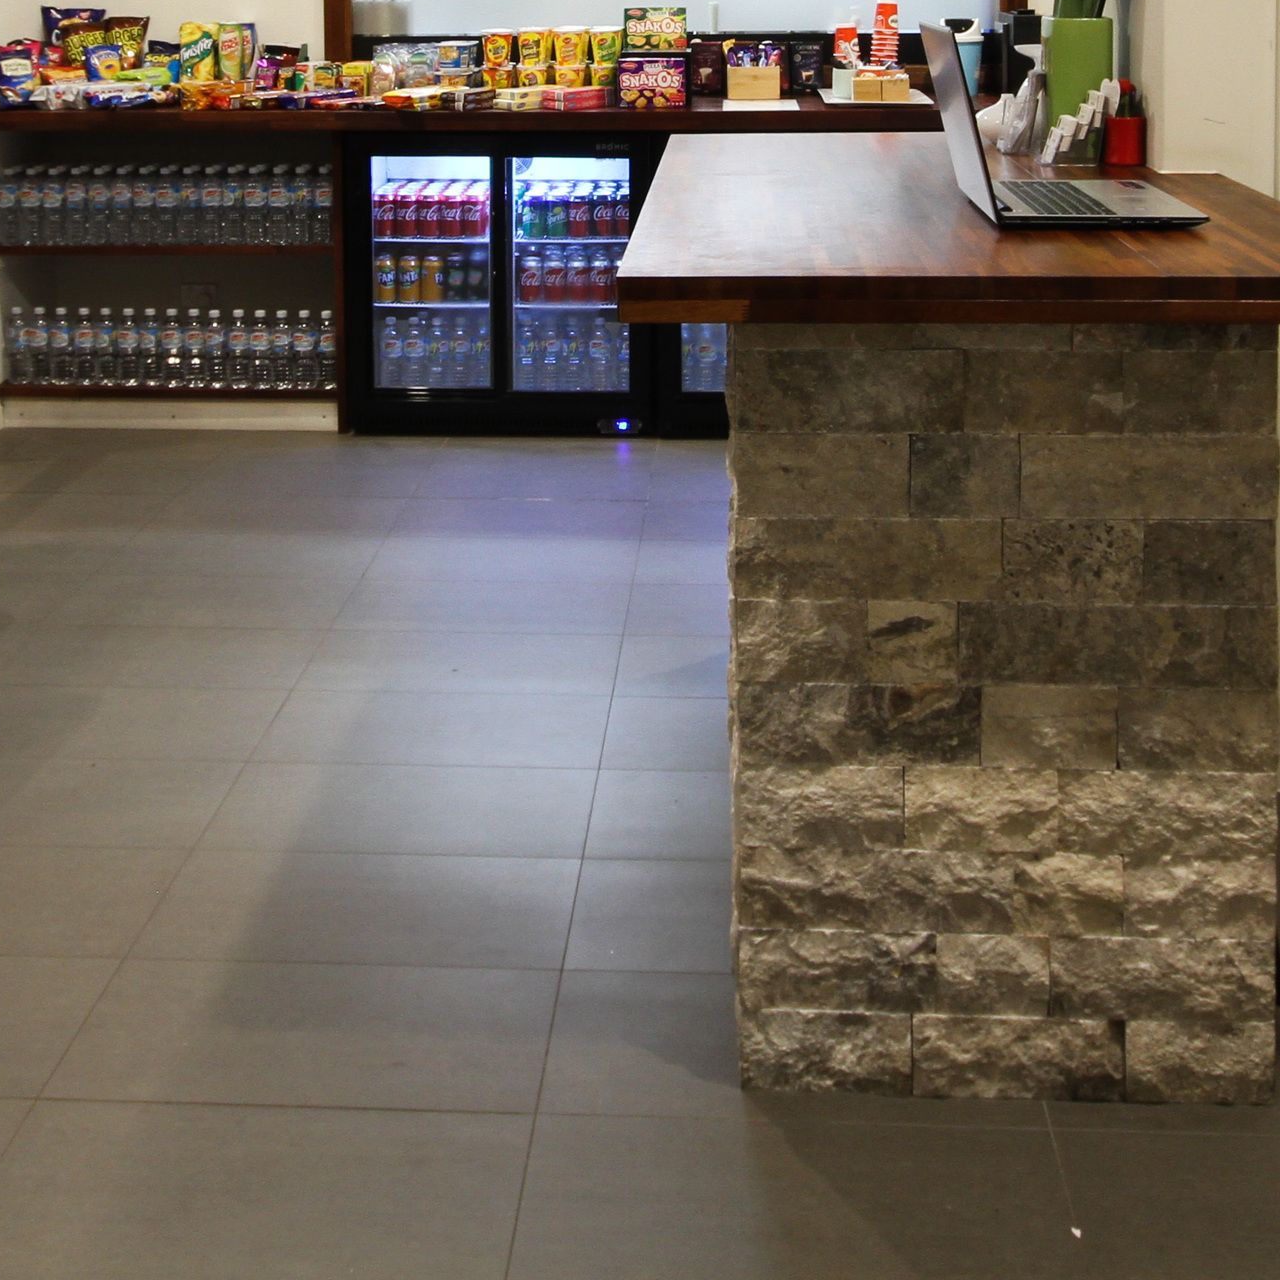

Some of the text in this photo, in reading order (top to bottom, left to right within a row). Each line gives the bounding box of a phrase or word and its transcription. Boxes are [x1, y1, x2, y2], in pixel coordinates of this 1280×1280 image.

[628, 17, 683, 34] SNAKOS
[64, 30, 107, 53] BURGER
[106, 27, 144, 46] URGER
[621, 70, 680, 88] SNAKOS
